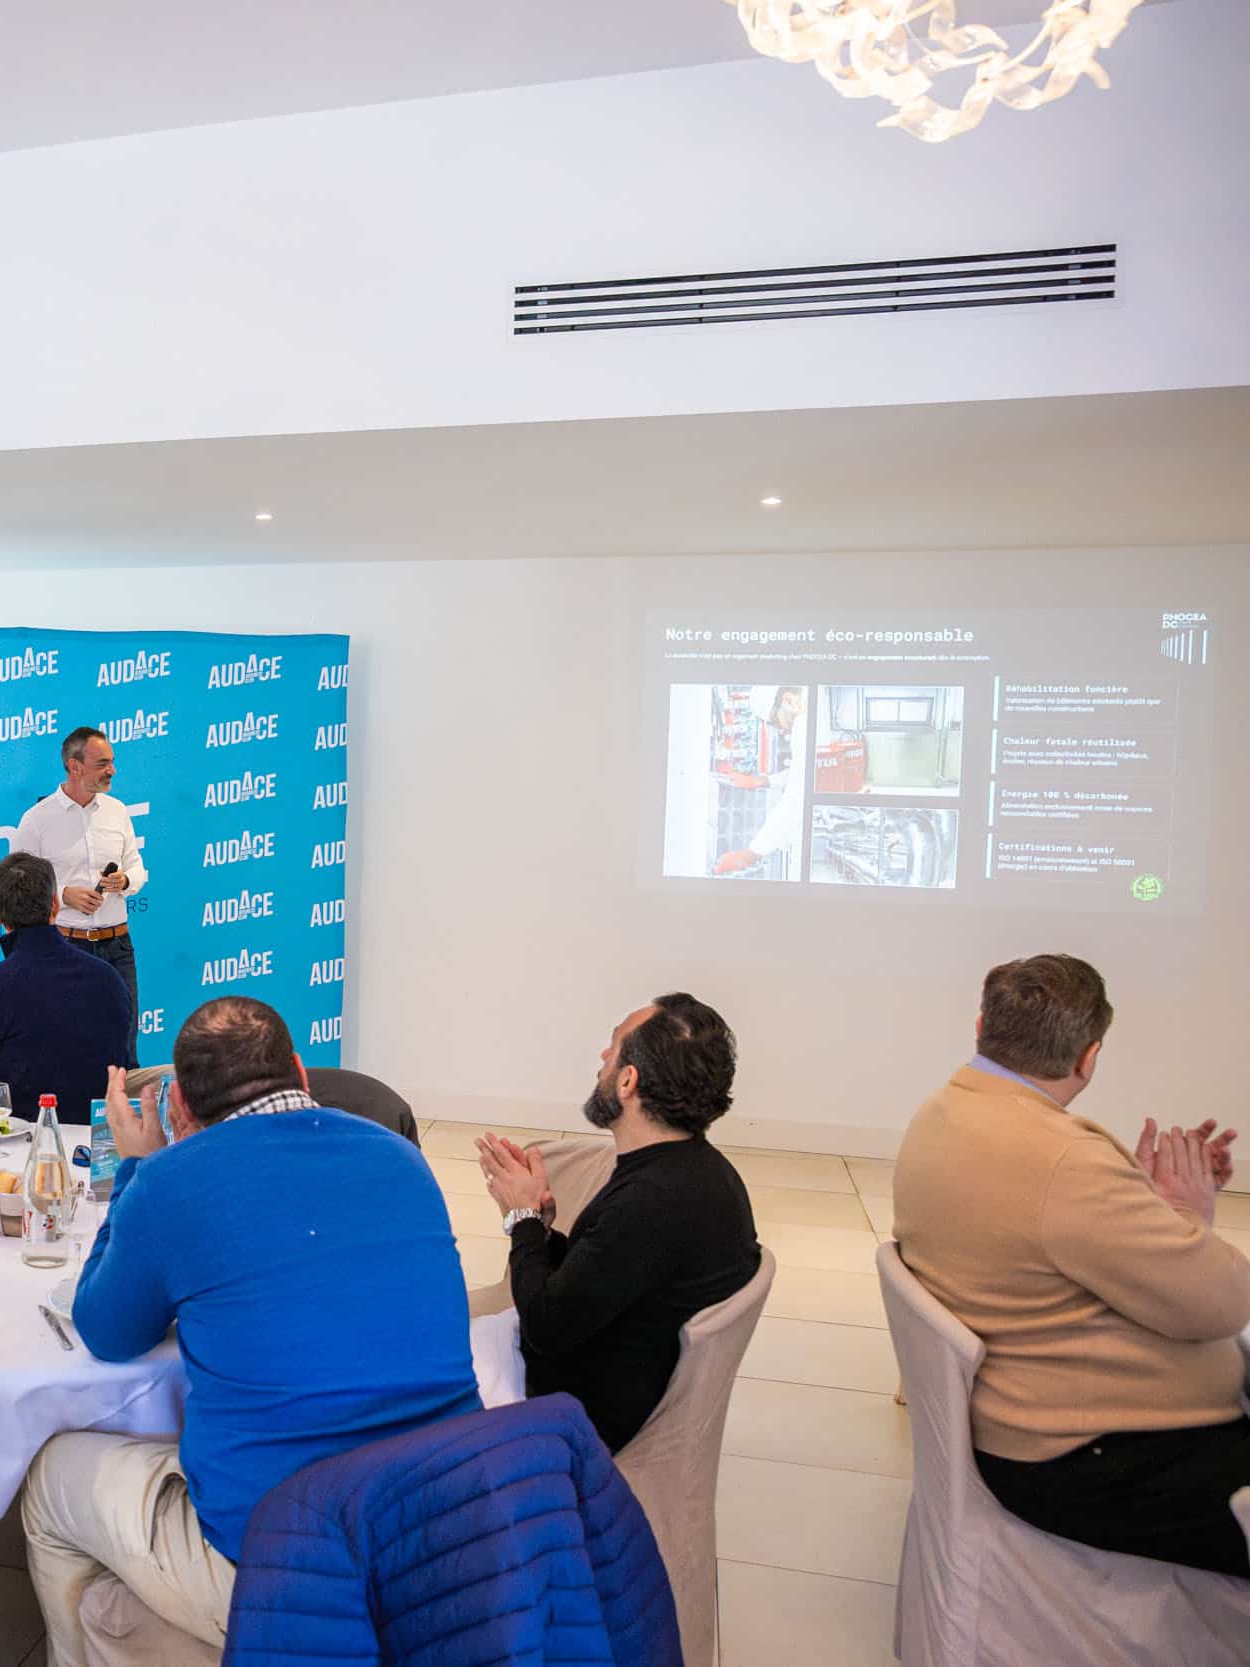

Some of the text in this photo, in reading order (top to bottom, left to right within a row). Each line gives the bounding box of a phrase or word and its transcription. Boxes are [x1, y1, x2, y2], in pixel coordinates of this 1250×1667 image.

[665, 627, 975, 645] Notre engagement éco-responsable
[96, 649, 172, 688] AUDACE
[207, 653, 284, 690] AUDACE
[205, 710, 280, 749] AUDACE
[204, 770, 278, 808] AUDACE
[203, 829, 276, 869] AUDACE
[201, 888, 275, 928] AUDACE
[310, 899, 346, 928] AUD
[200, 947, 274, 987] AUDACE
